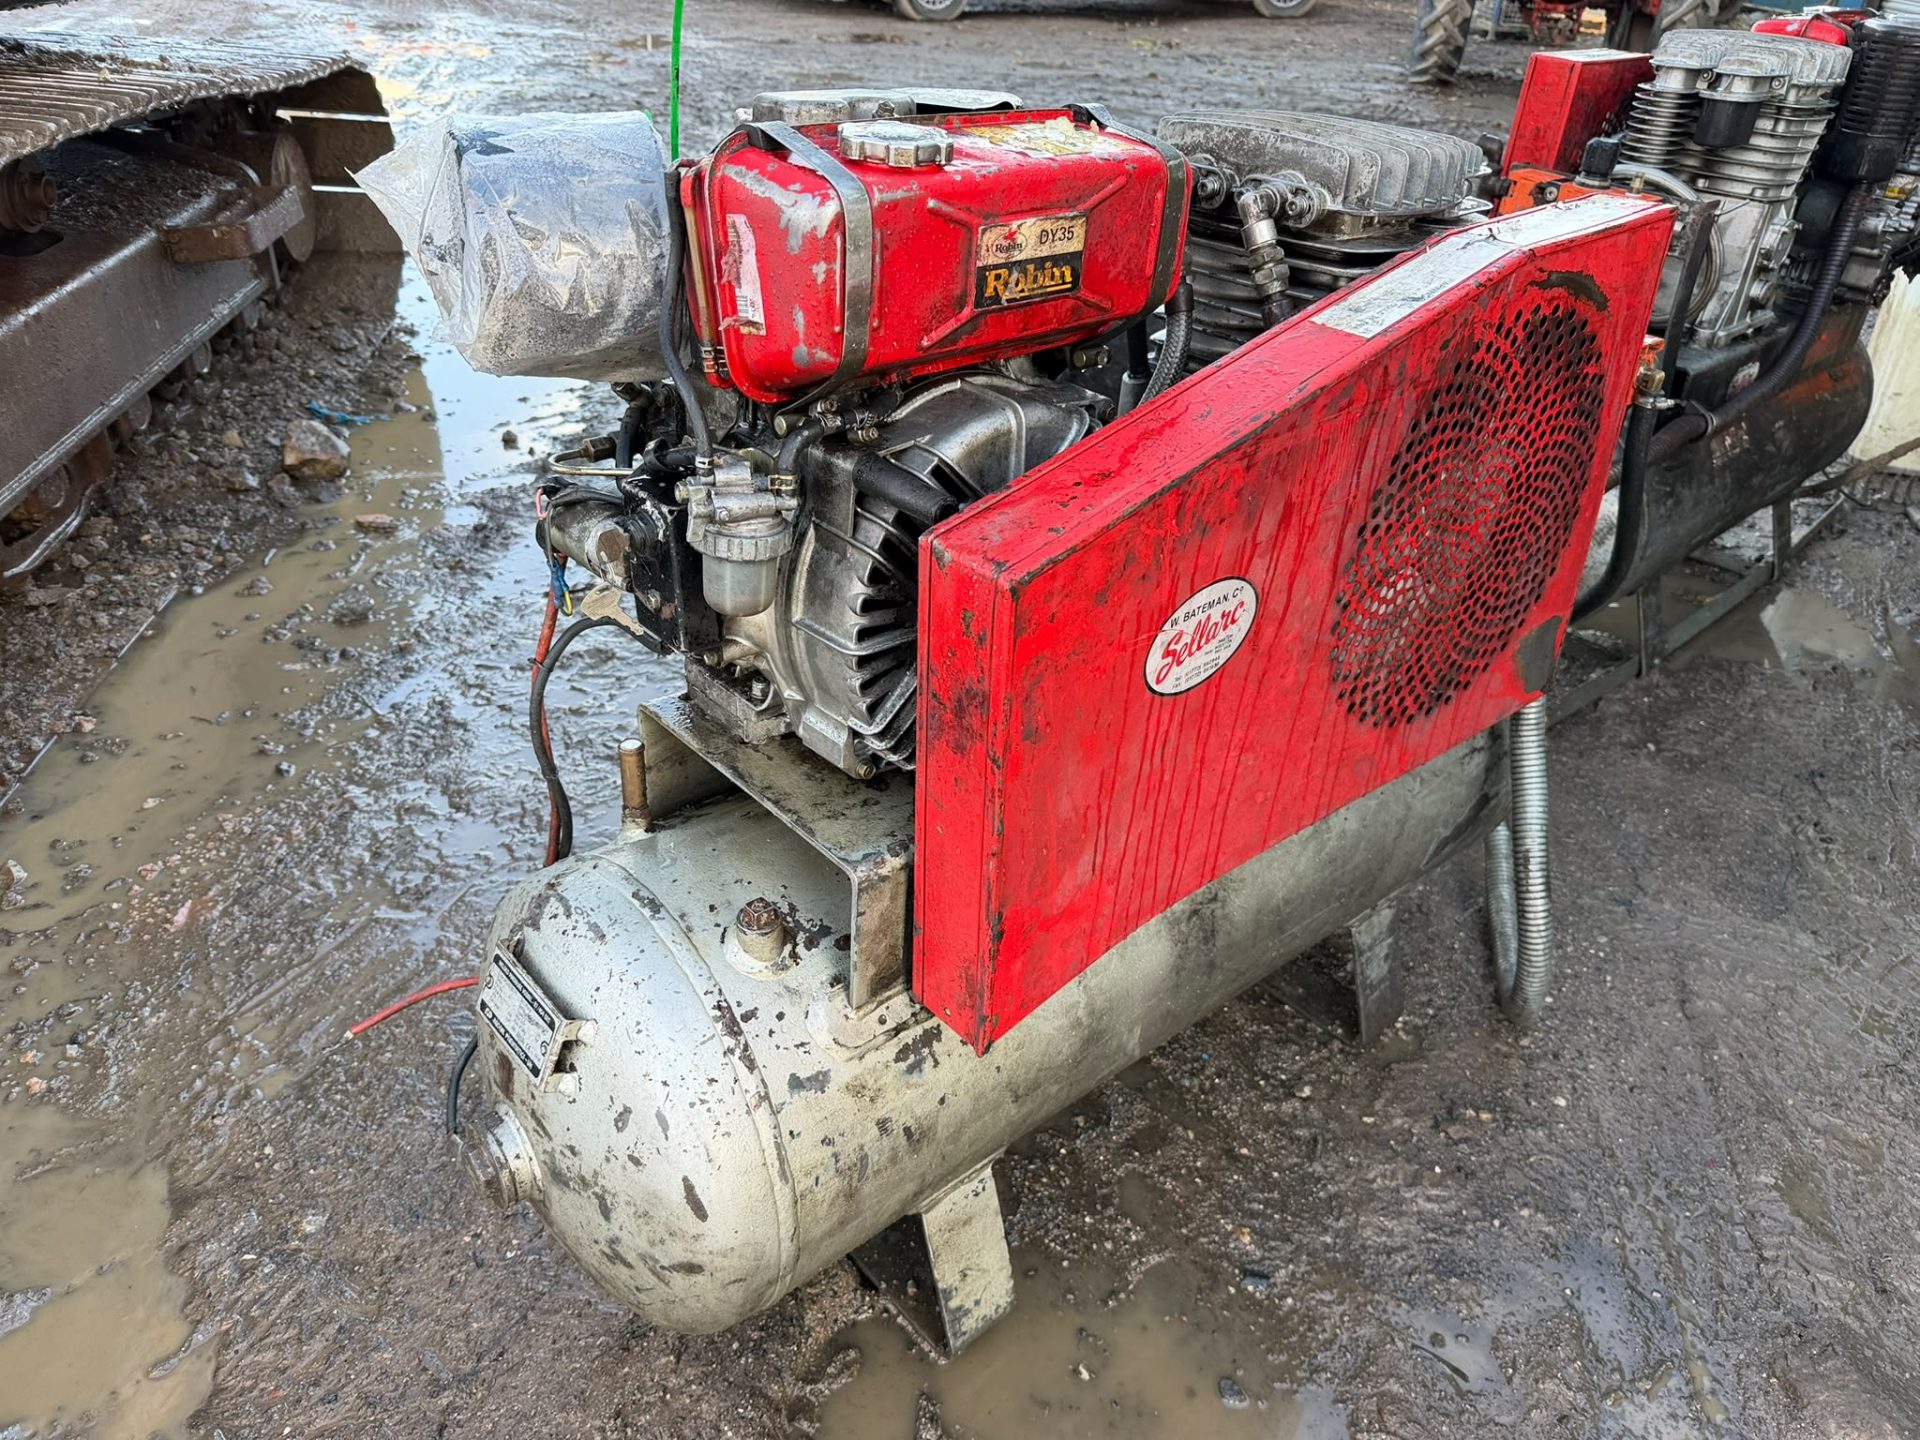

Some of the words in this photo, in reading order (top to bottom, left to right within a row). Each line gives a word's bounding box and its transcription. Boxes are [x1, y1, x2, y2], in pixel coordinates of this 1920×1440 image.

[995, 241, 1023, 254] Robin
[983, 261, 1073, 298] Robin
[1155, 600, 1246, 686] Sellarc
